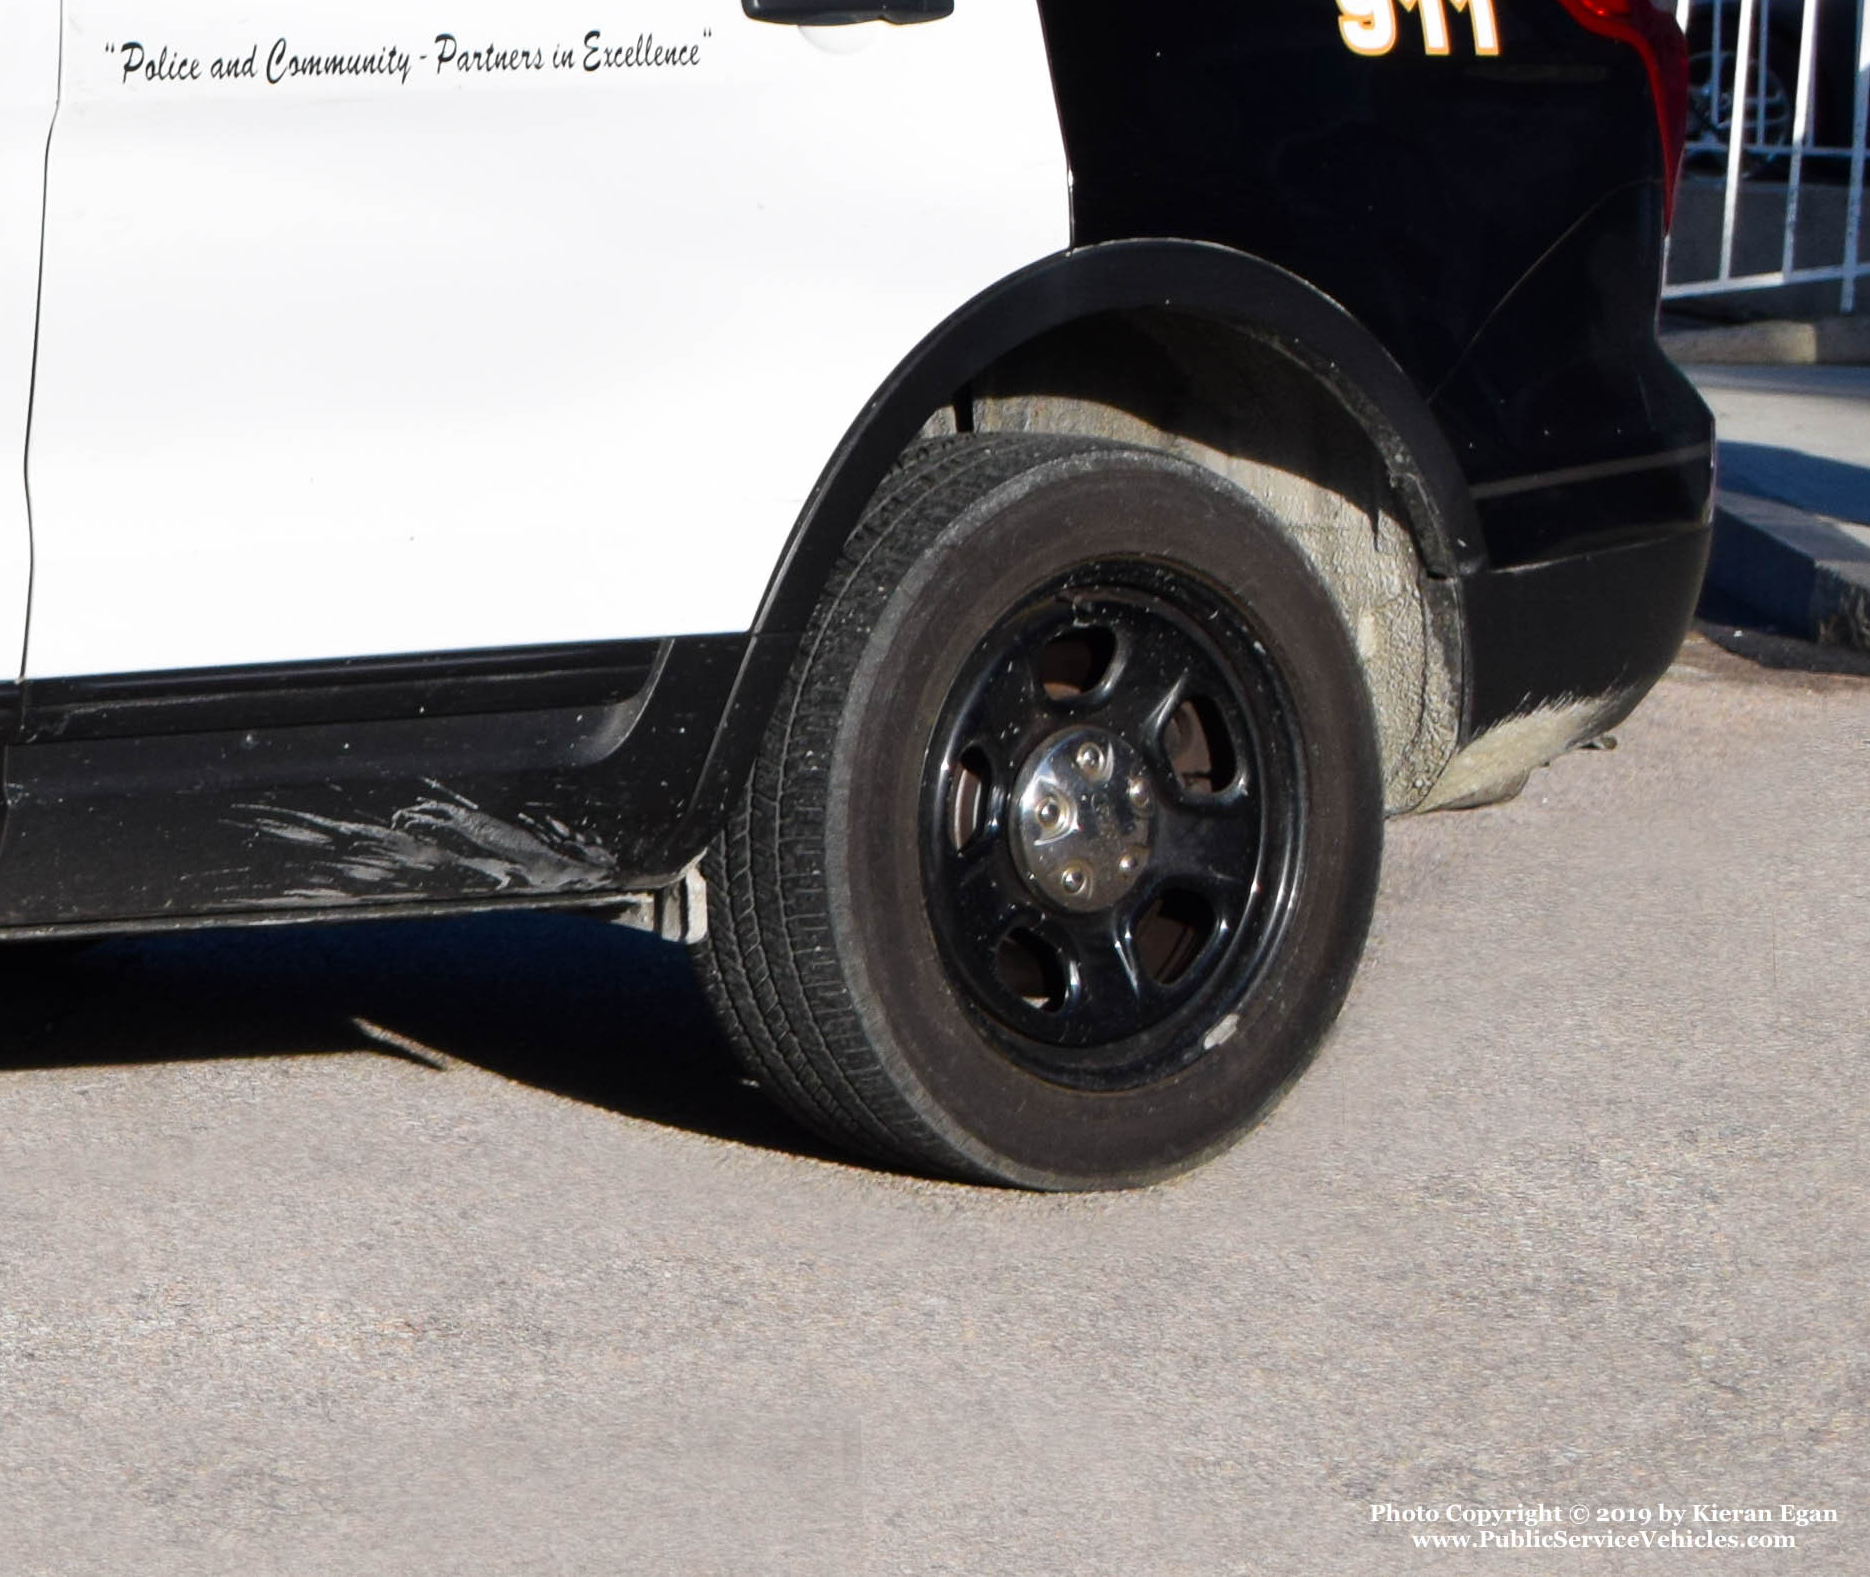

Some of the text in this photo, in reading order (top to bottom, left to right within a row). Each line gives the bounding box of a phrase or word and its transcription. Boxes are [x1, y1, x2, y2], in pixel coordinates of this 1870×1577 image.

[211, 43, 259, 79] and
[266, 37, 412, 85] Community
[434, 33, 545, 75] Partners
[552, 42, 575, 70] in
